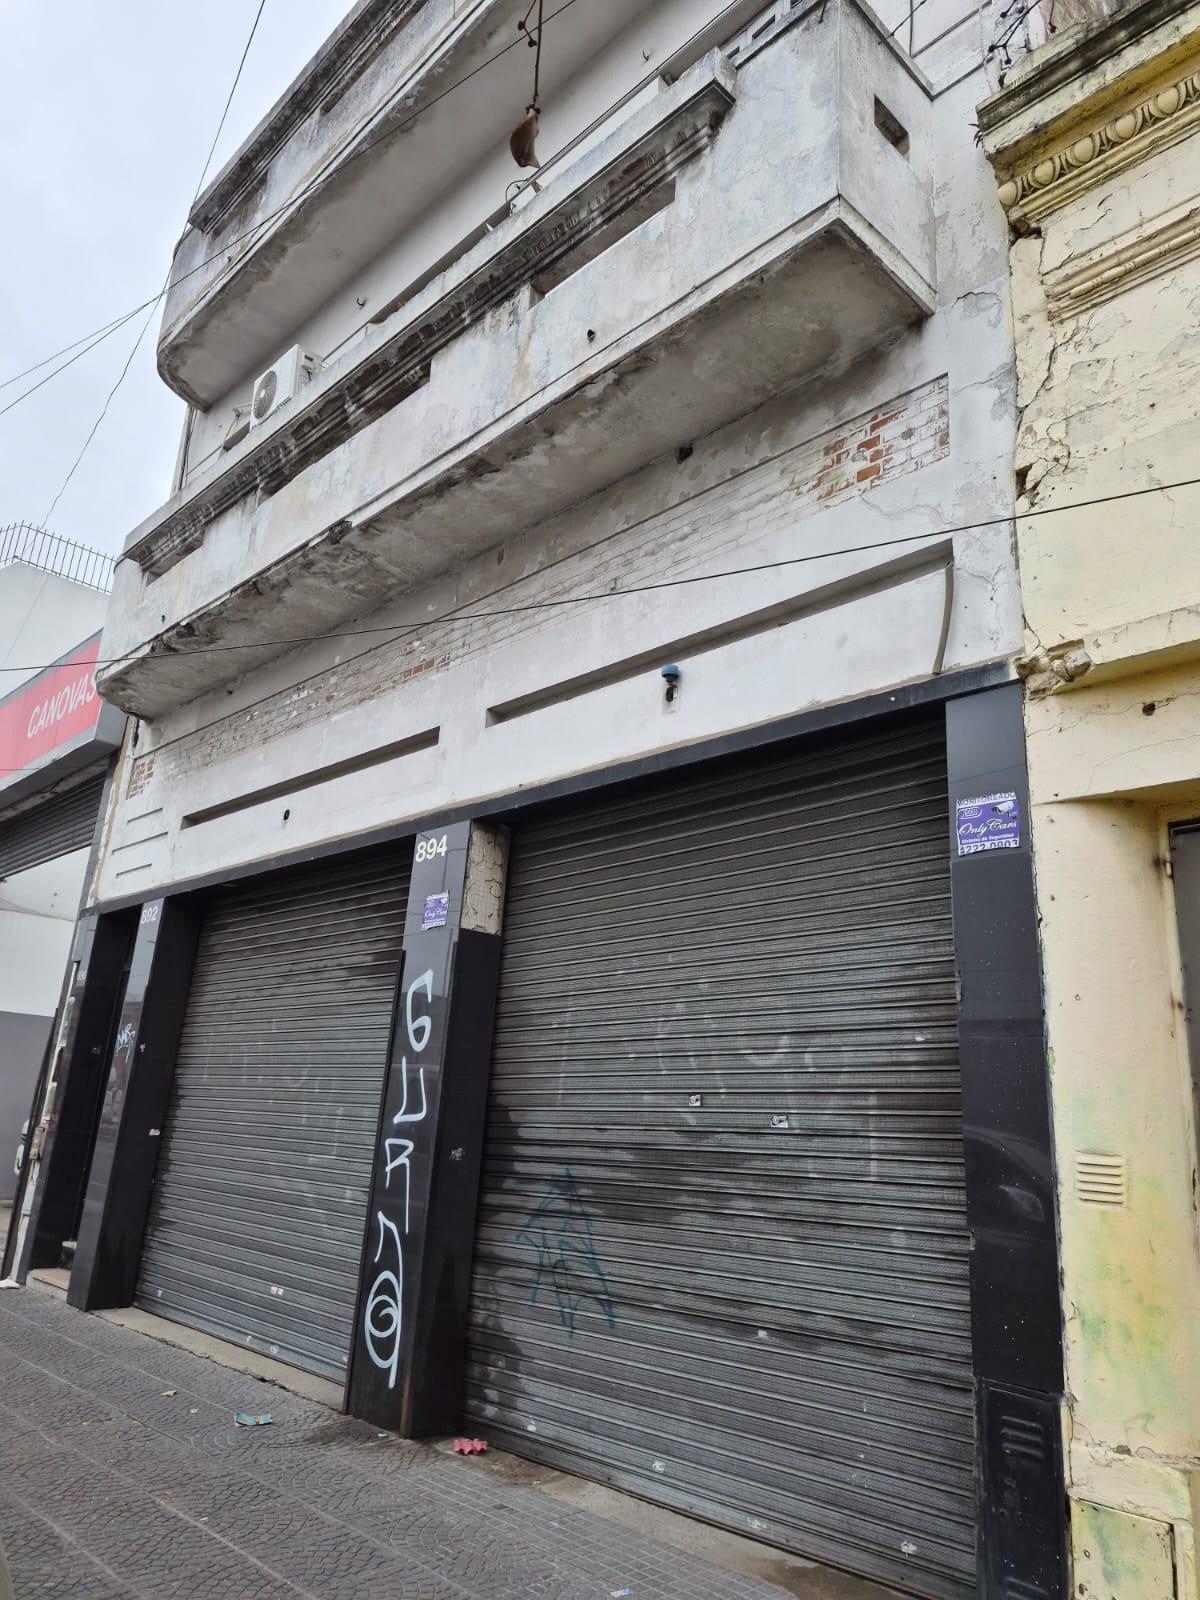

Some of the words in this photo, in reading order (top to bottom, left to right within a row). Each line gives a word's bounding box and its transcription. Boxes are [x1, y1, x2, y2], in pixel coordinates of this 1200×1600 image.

[27, 673, 97, 739] CANOVAS
[415, 834, 447, 862] 894
[140, 905, 158, 924] 892
